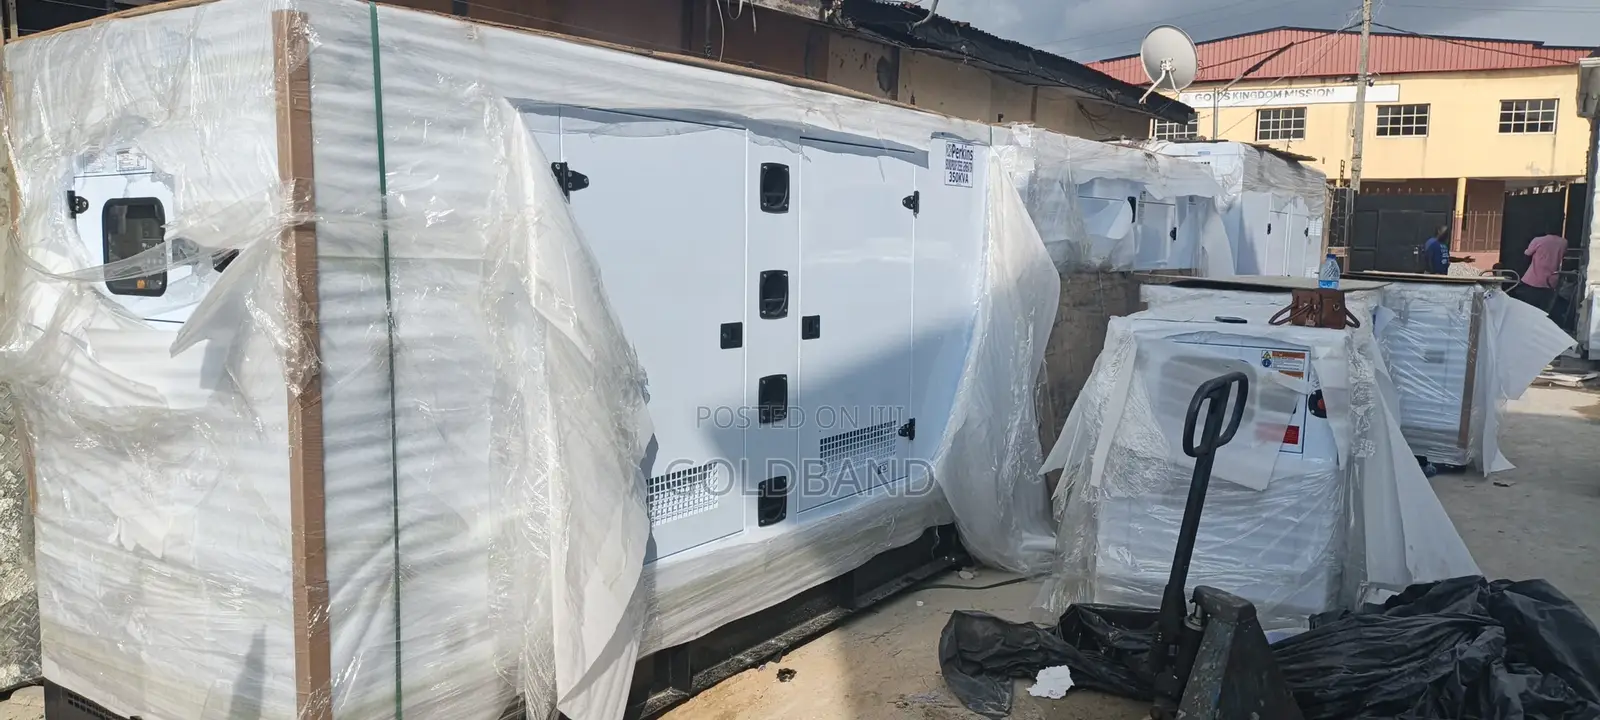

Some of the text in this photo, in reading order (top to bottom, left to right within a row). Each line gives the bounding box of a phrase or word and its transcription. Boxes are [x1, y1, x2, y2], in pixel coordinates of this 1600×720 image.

[1232, 90, 1282, 100] KINGDOM
[1284, 88, 1335, 98] MISSION
[951, 143, 974, 161] Perkins
[949, 171, 969, 184] 350KVA
